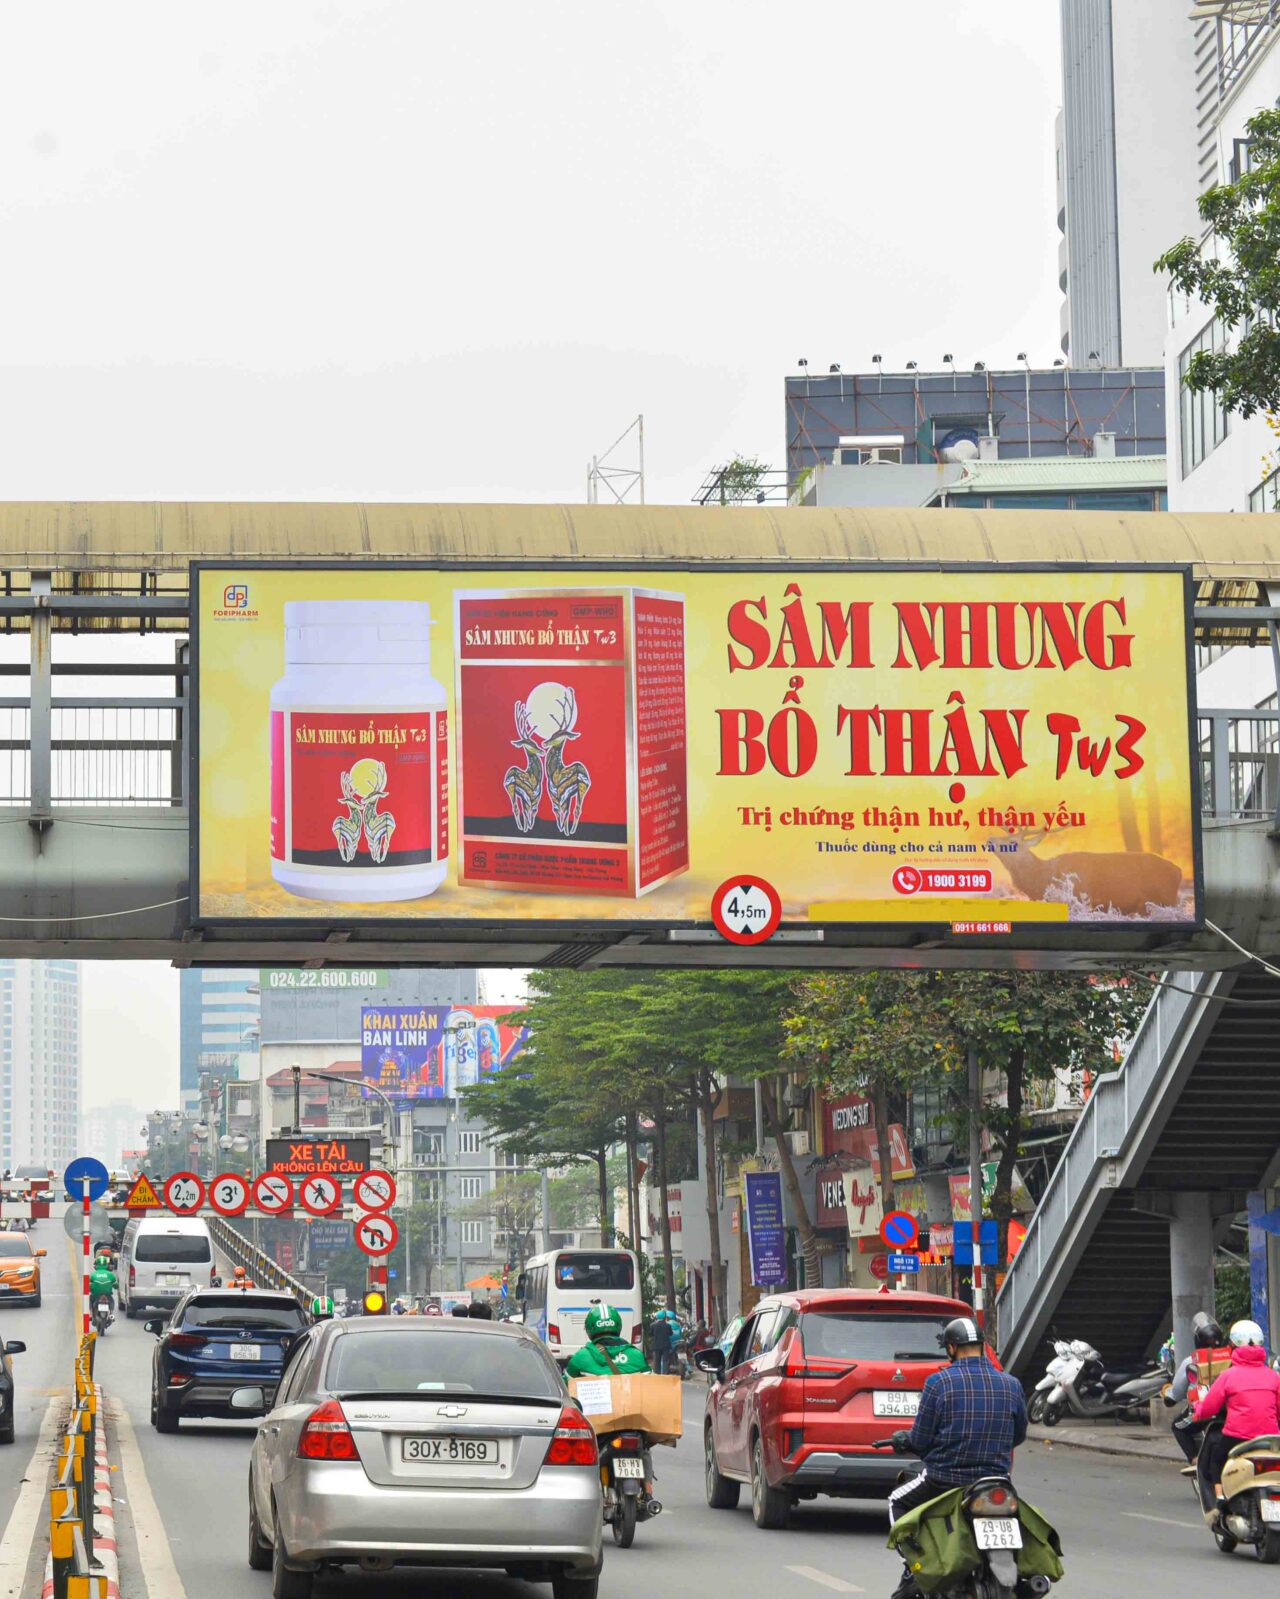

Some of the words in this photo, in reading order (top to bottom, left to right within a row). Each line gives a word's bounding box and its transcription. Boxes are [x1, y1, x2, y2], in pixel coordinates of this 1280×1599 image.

[466, 624, 491, 645] SÂM
[494, 630, 535, 645] NHUNG
[537, 619, 554, 645] BỔ
[557, 625, 590, 651] THẬN
[727, 582, 874, 674] SÂM
[890, 596, 1136, 672] NHUNG
[296, 724, 316, 743] SÂM
[318, 729, 356, 744] NHUNG
[359, 720, 376, 744] BỔ
[377, 724, 407, 749] THẬN
[714, 675, 818, 779] BỔ
[836, 690, 1030, 804] THẬN
[737, 806, 773, 832] Trị
[779, 806, 855, 830] chứng
[863, 805, 920, 833] thận
[928, 807, 970, 831] hư,
[977, 805, 1036, 833] thận
[1042, 801, 1087, 831] yếu
[815, 838, 858, 853] Thuốc
[862, 841, 897, 855] dùng
[900, 841, 925, 853] cho
[928, 840, 944, 853] cả
[947, 843, 977, 853] nam
[980, 840, 996, 853] và
[999, 840, 1018, 853] nữ
[927, 875, 955, 888] 1900
[958, 875, 987, 888] 3199
[727, 896, 766, 918] 4,5m
[955, 924, 975, 933] 0911
[977, 924, 991, 932] 661
[993, 924, 1009, 932] 666
[269, 971, 378, 987] 024.22.600.600
[363, 1014, 397, 1029] KHAI
[399, 1011, 438, 1029] XUÂN
[832, 1106, 857, 1130] WEDDING
[289, 1145, 312, 1160] XE
[317, 1139, 346, 1160] TẢI
[273, 1161, 315, 1172] KHÔNG
[317, 1161, 337, 1172] LÊN
[339, 1160, 363, 1172] CẦU
[822, 1180, 846, 1208] VENE
[887, 1393, 908, 1403] 89A
[880, 1404, 917, 1414] 394.89
[409, 1441, 488, 1460] 30X-8169
[981, 1521, 1013, 1533] 29-U8
[983, 1534, 1016, 1547] 2262
